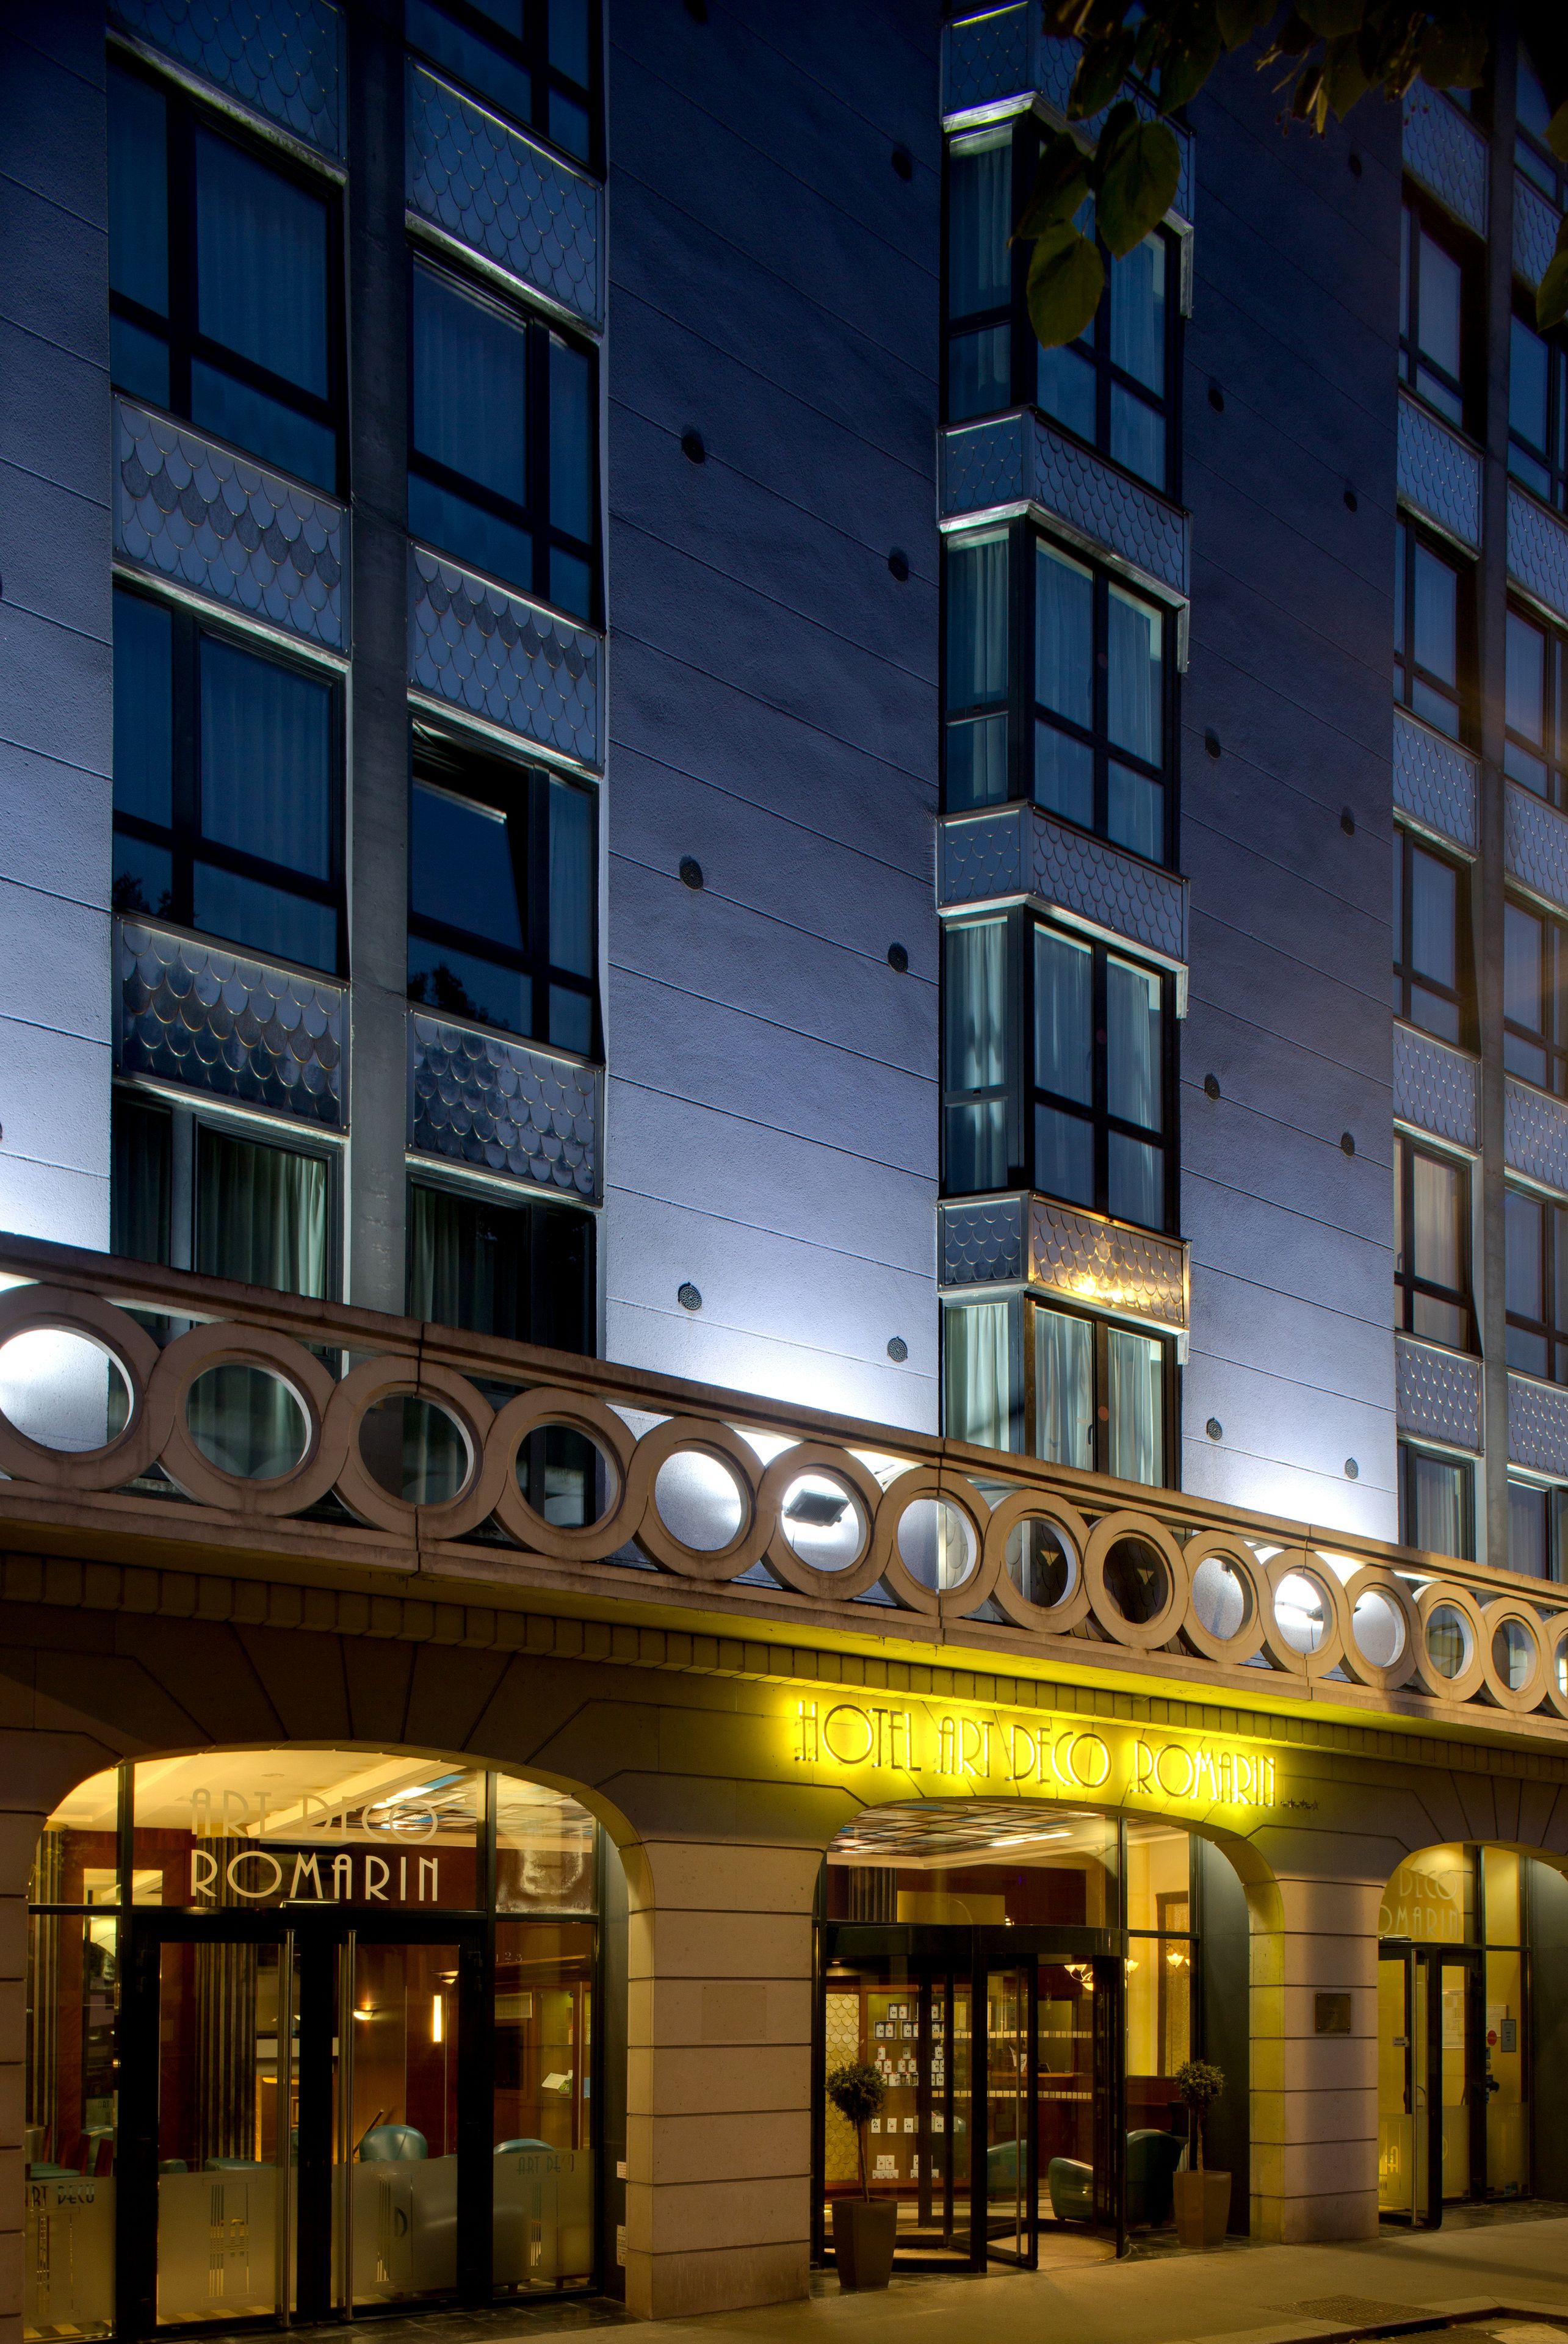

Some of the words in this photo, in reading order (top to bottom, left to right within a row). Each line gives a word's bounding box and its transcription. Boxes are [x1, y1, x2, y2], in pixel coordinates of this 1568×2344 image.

[797, 1700, 922, 1771] HOTEL
[937, 1716, 994, 1778] ART
[1009, 1724, 1111, 1788] DECO
[1133, 1739, 1276, 1807] ROMARIN
[189, 1788, 272, 1836] ART
[303, 1793, 438, 1844] DECO
[191, 1849, 438, 1901] ROMARIN
[1400, 1869, 1458, 1900] DECO
[1378, 1904, 1459, 1939] OMARIN
